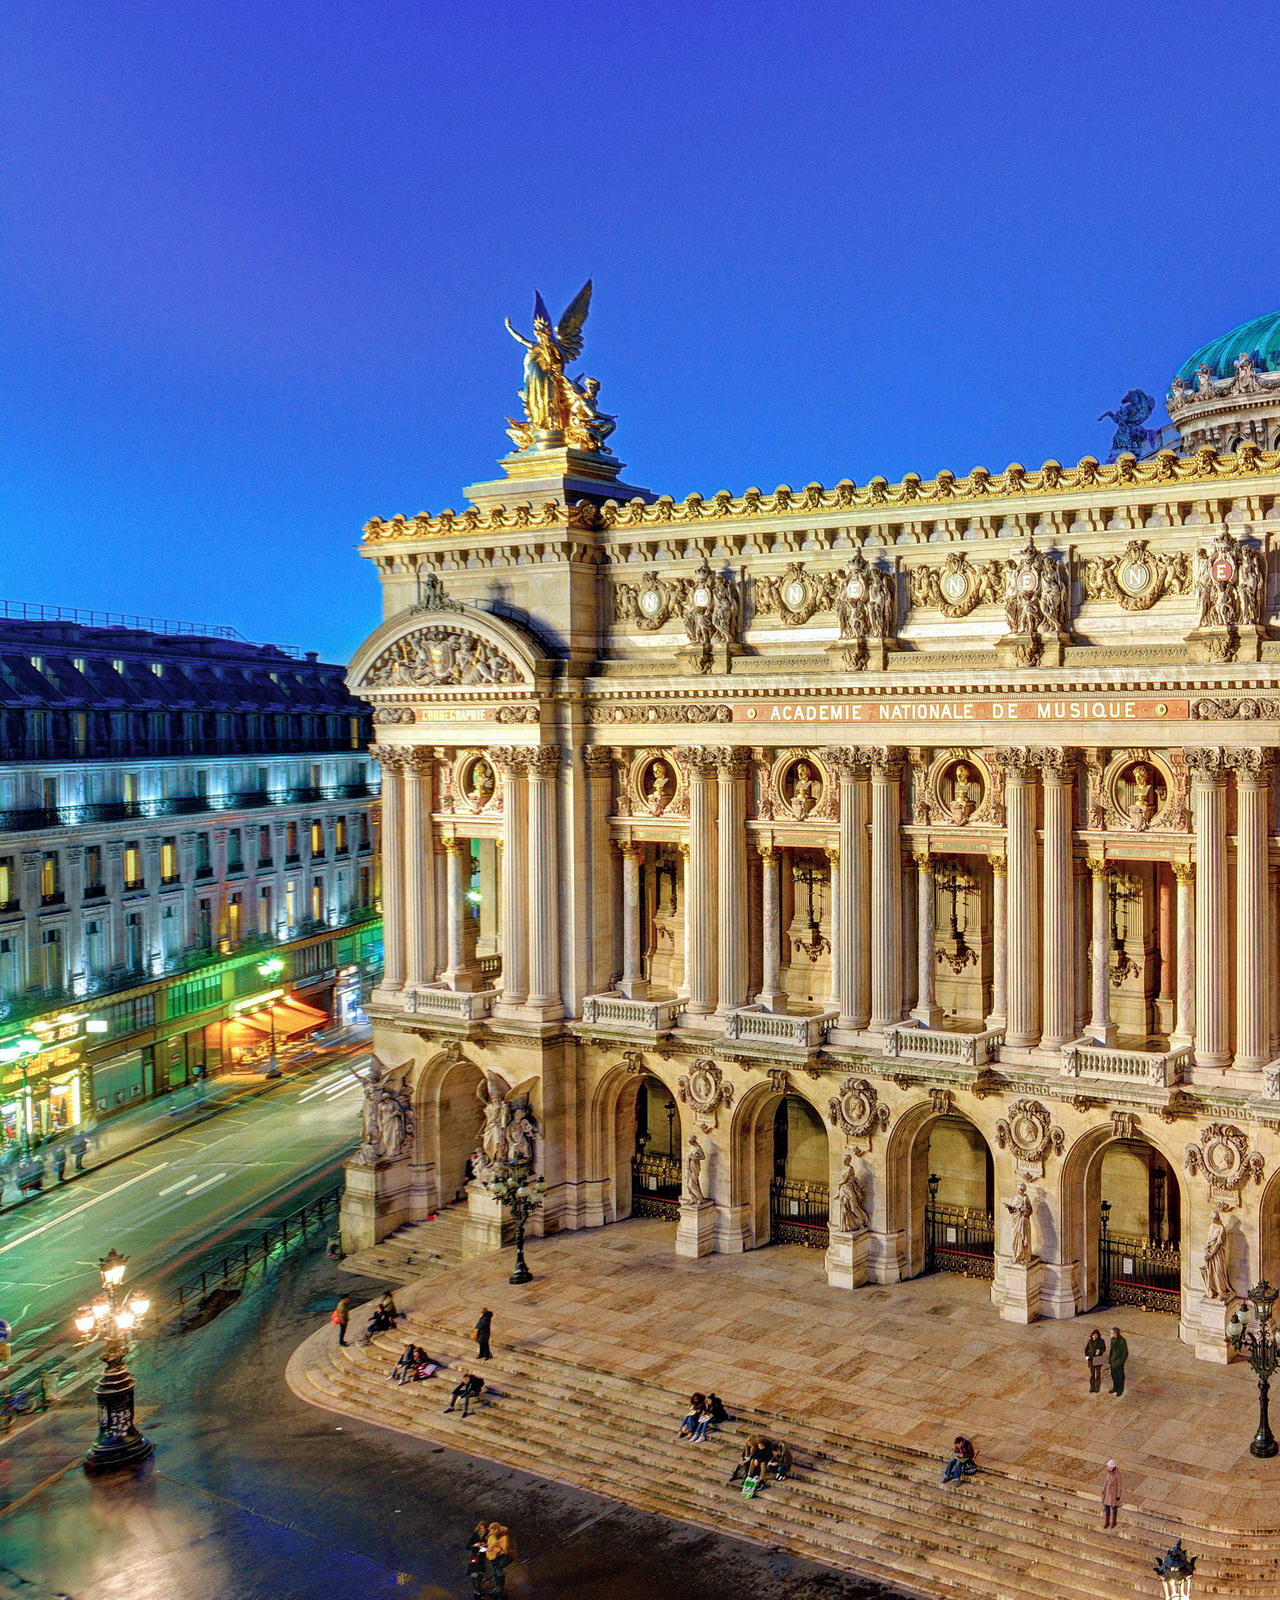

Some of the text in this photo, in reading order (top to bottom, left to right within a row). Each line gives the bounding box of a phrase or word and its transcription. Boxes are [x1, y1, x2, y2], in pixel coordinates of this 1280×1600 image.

[1130, 569, 1141, 584] N
[1216, 564, 1227, 578] E
[949, 579, 960, 593] N
[1022, 576, 1031, 589] E
[789, 587, 799, 602] N
[850, 584, 859, 596] E
[643, 595, 655, 610] N
[769, 702, 1136, 720] ACADEMIE NATIONALE DE MUSIQUE
